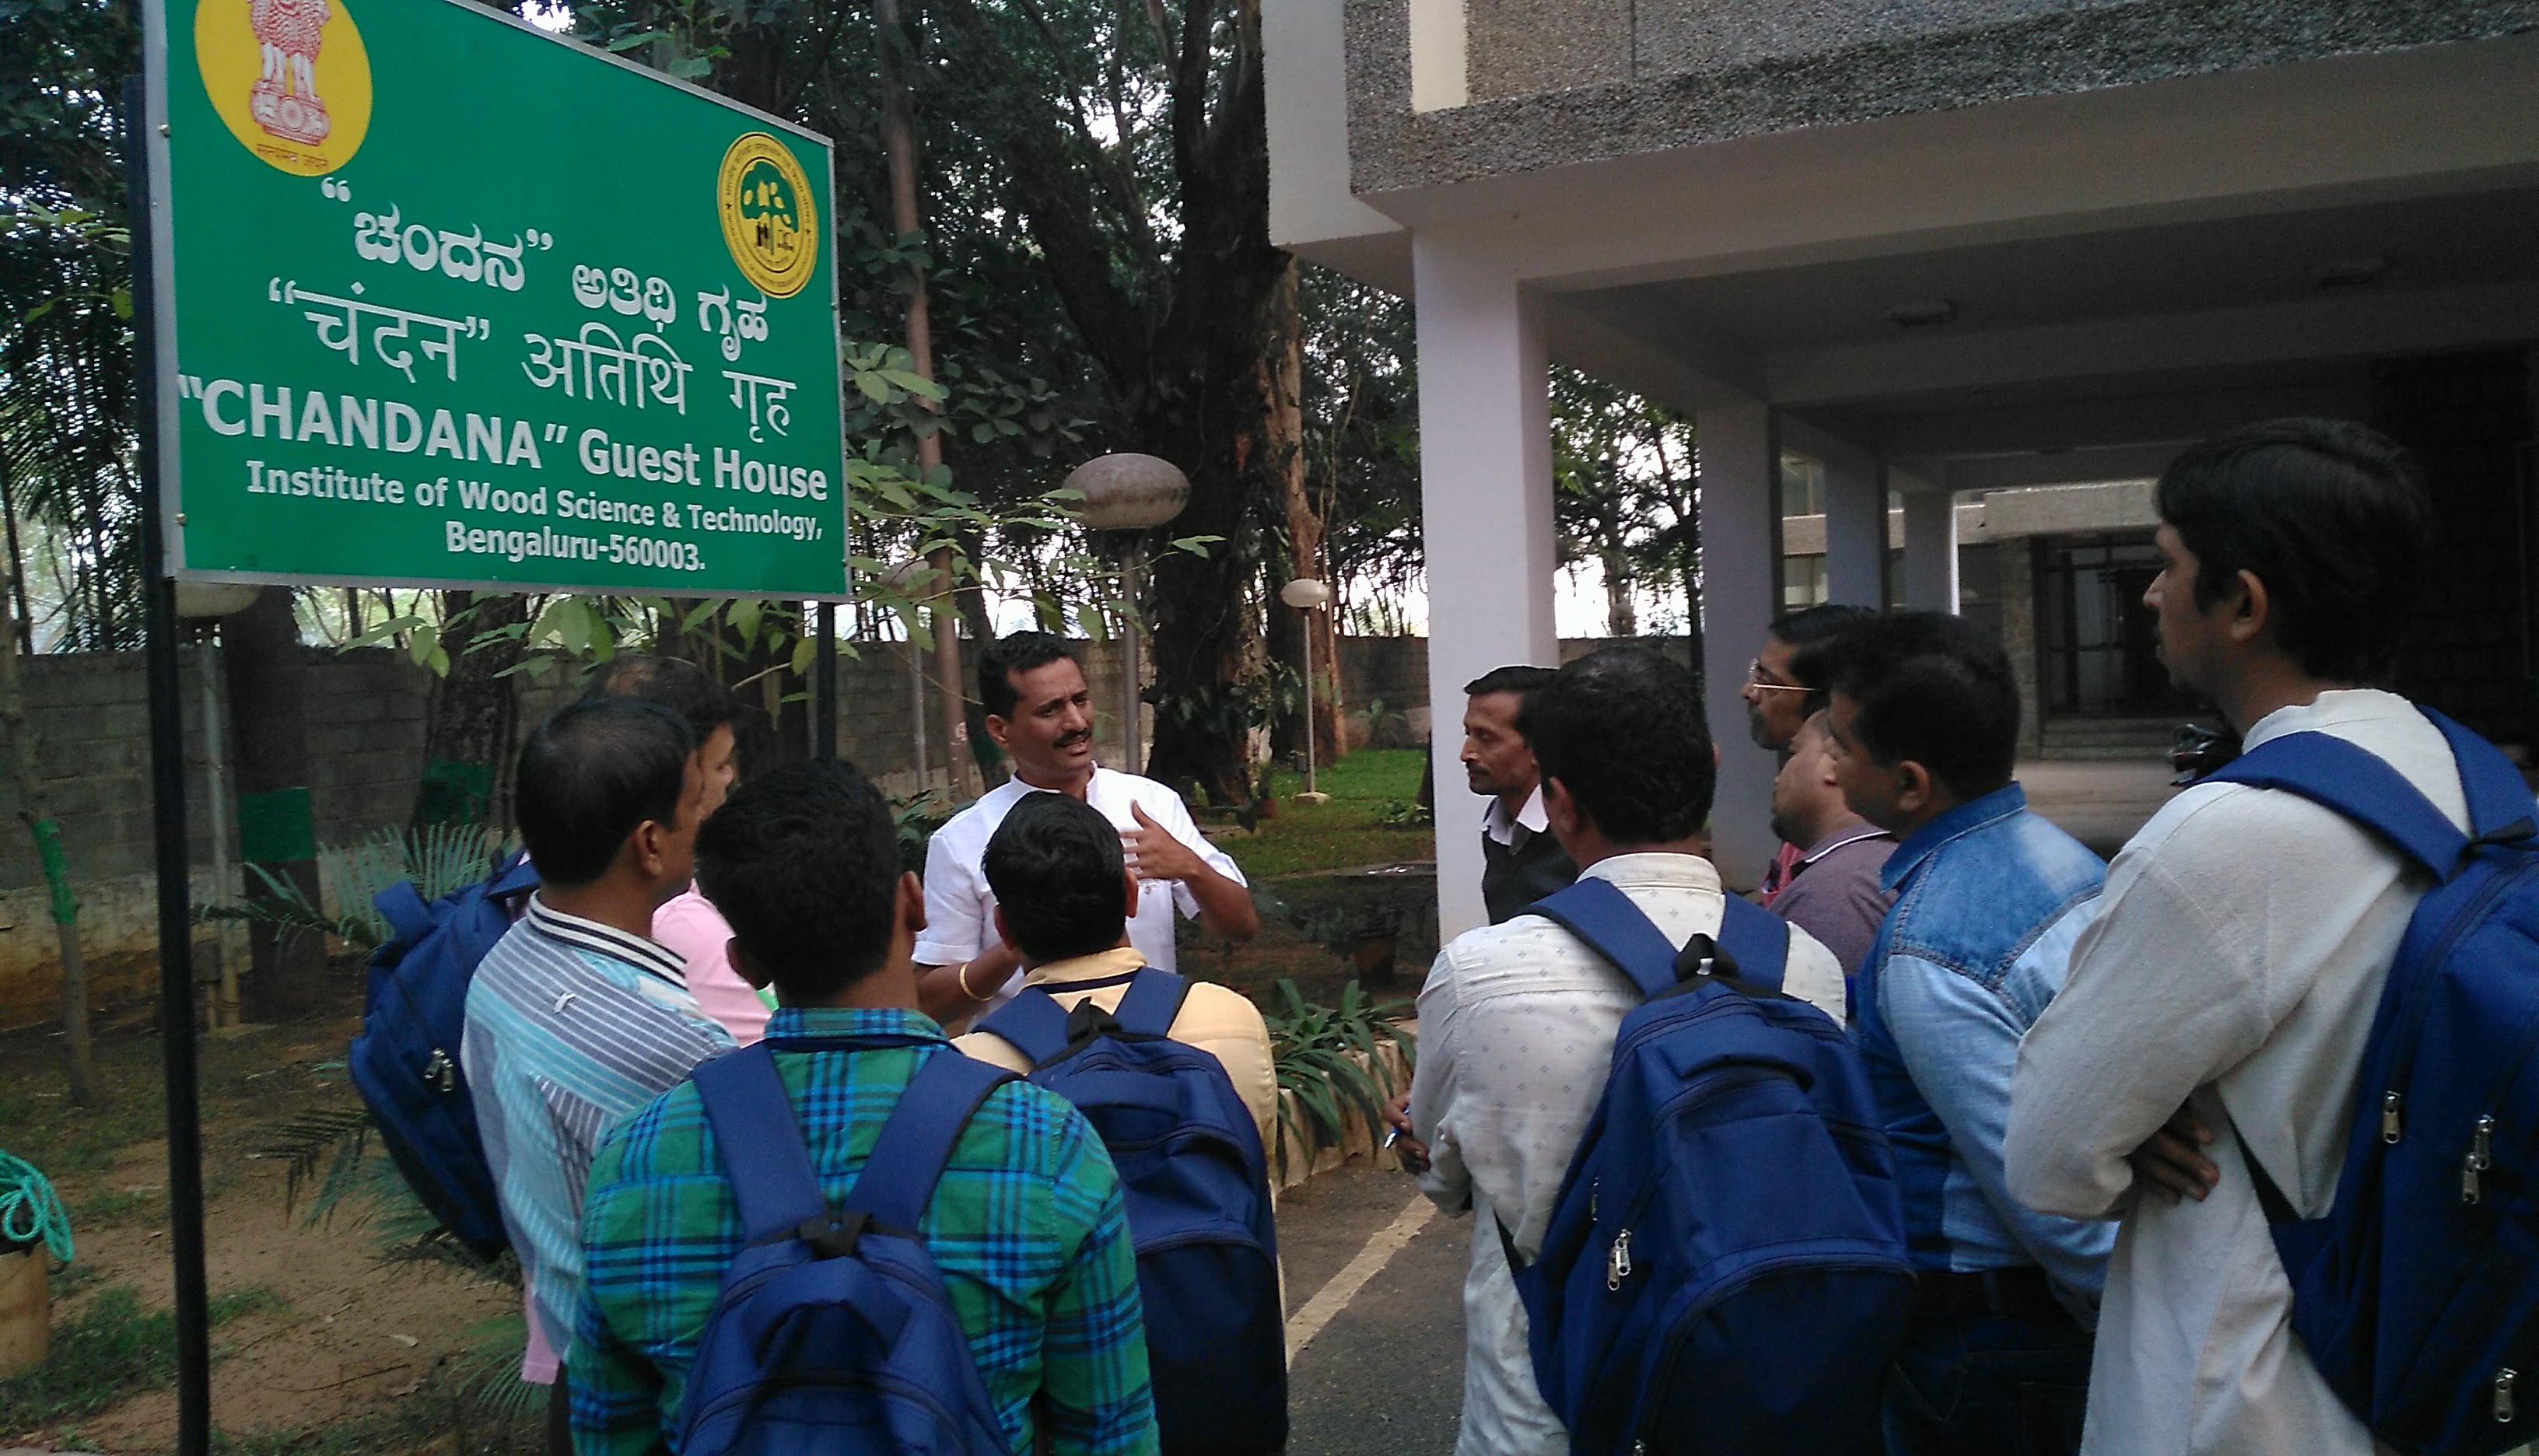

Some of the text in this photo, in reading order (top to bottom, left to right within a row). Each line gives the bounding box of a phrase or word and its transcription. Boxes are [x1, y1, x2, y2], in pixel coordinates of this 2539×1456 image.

[697, 282, 769, 362] ಗೃಹ
[521, 321, 694, 415] अतिथि
[720, 369, 797, 444] गृह
[246, 460, 823, 541] Institute of Wood Science & Technology,
[578, 429, 701, 486] Guest
[713, 446, 828, 501] House
[446, 521, 706, 571] Bengaluru-560003.
